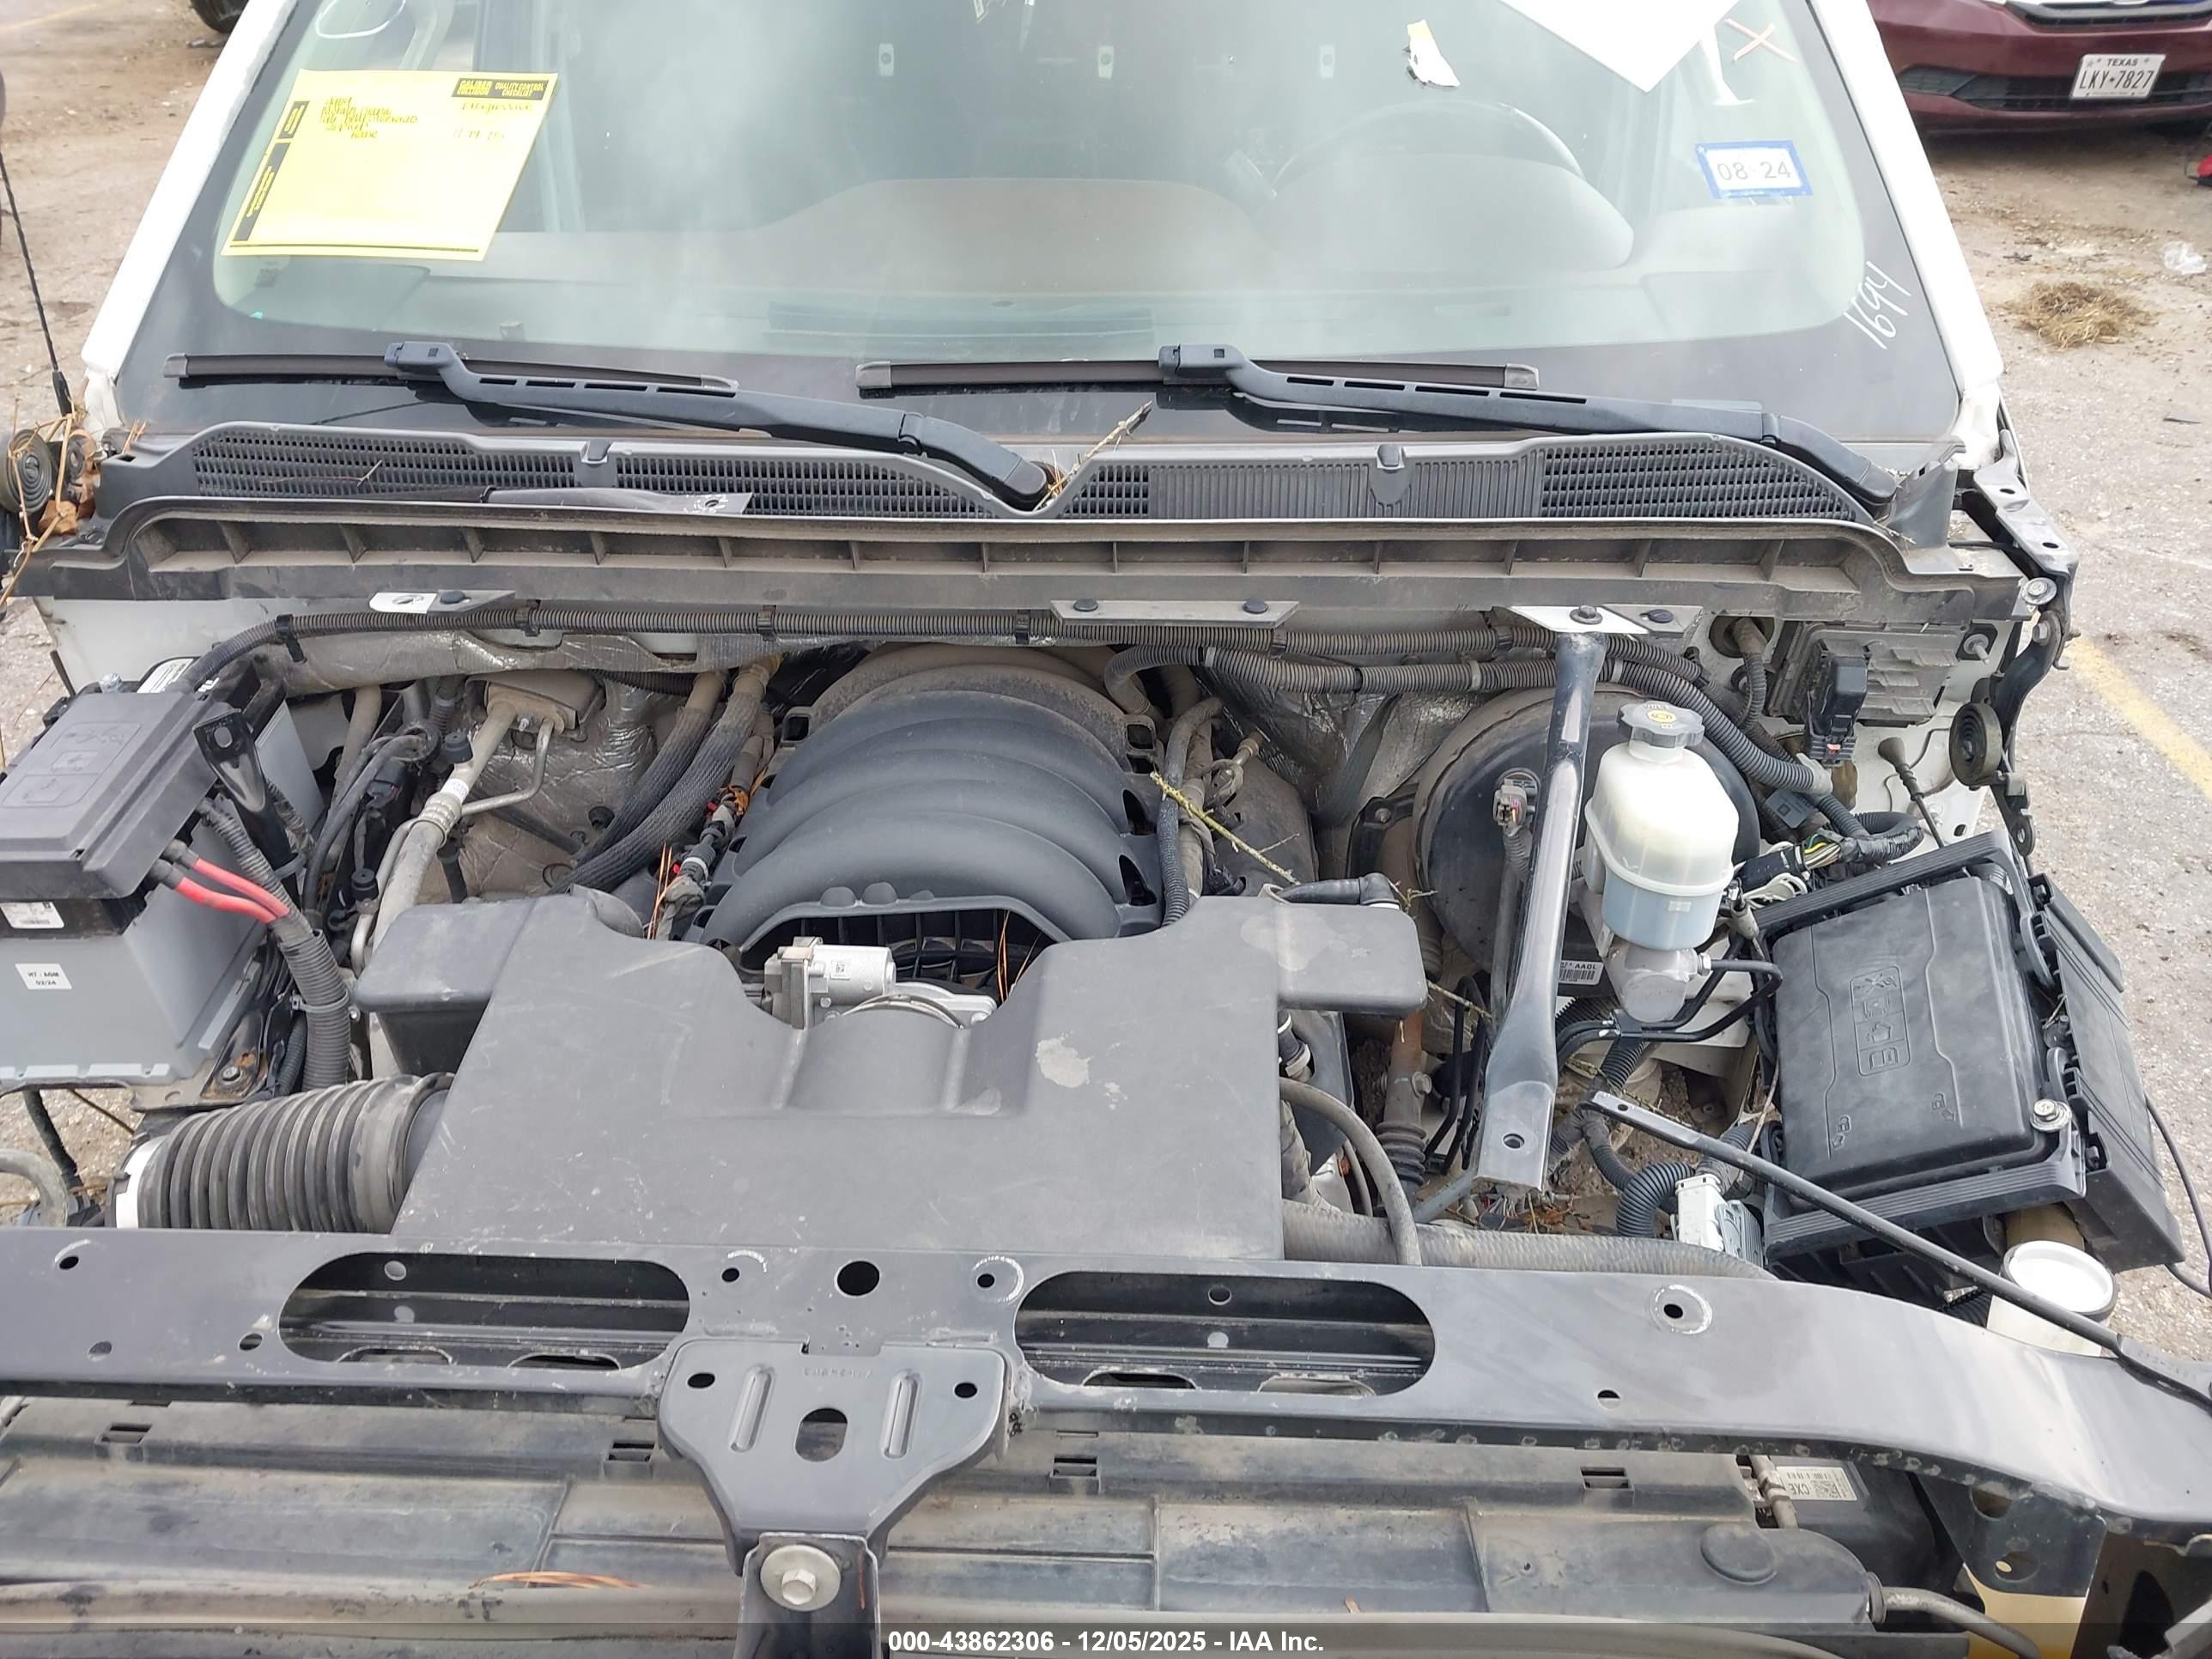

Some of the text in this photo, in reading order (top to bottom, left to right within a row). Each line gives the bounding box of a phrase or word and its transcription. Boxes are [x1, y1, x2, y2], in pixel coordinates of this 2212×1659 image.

[2106, 58, 2139, 67] TEXAS
[494, 82, 520, 91] QUALITY
[1717, 161, 1792, 181] 08 24
[1842, 260, 1912, 349] 1694
